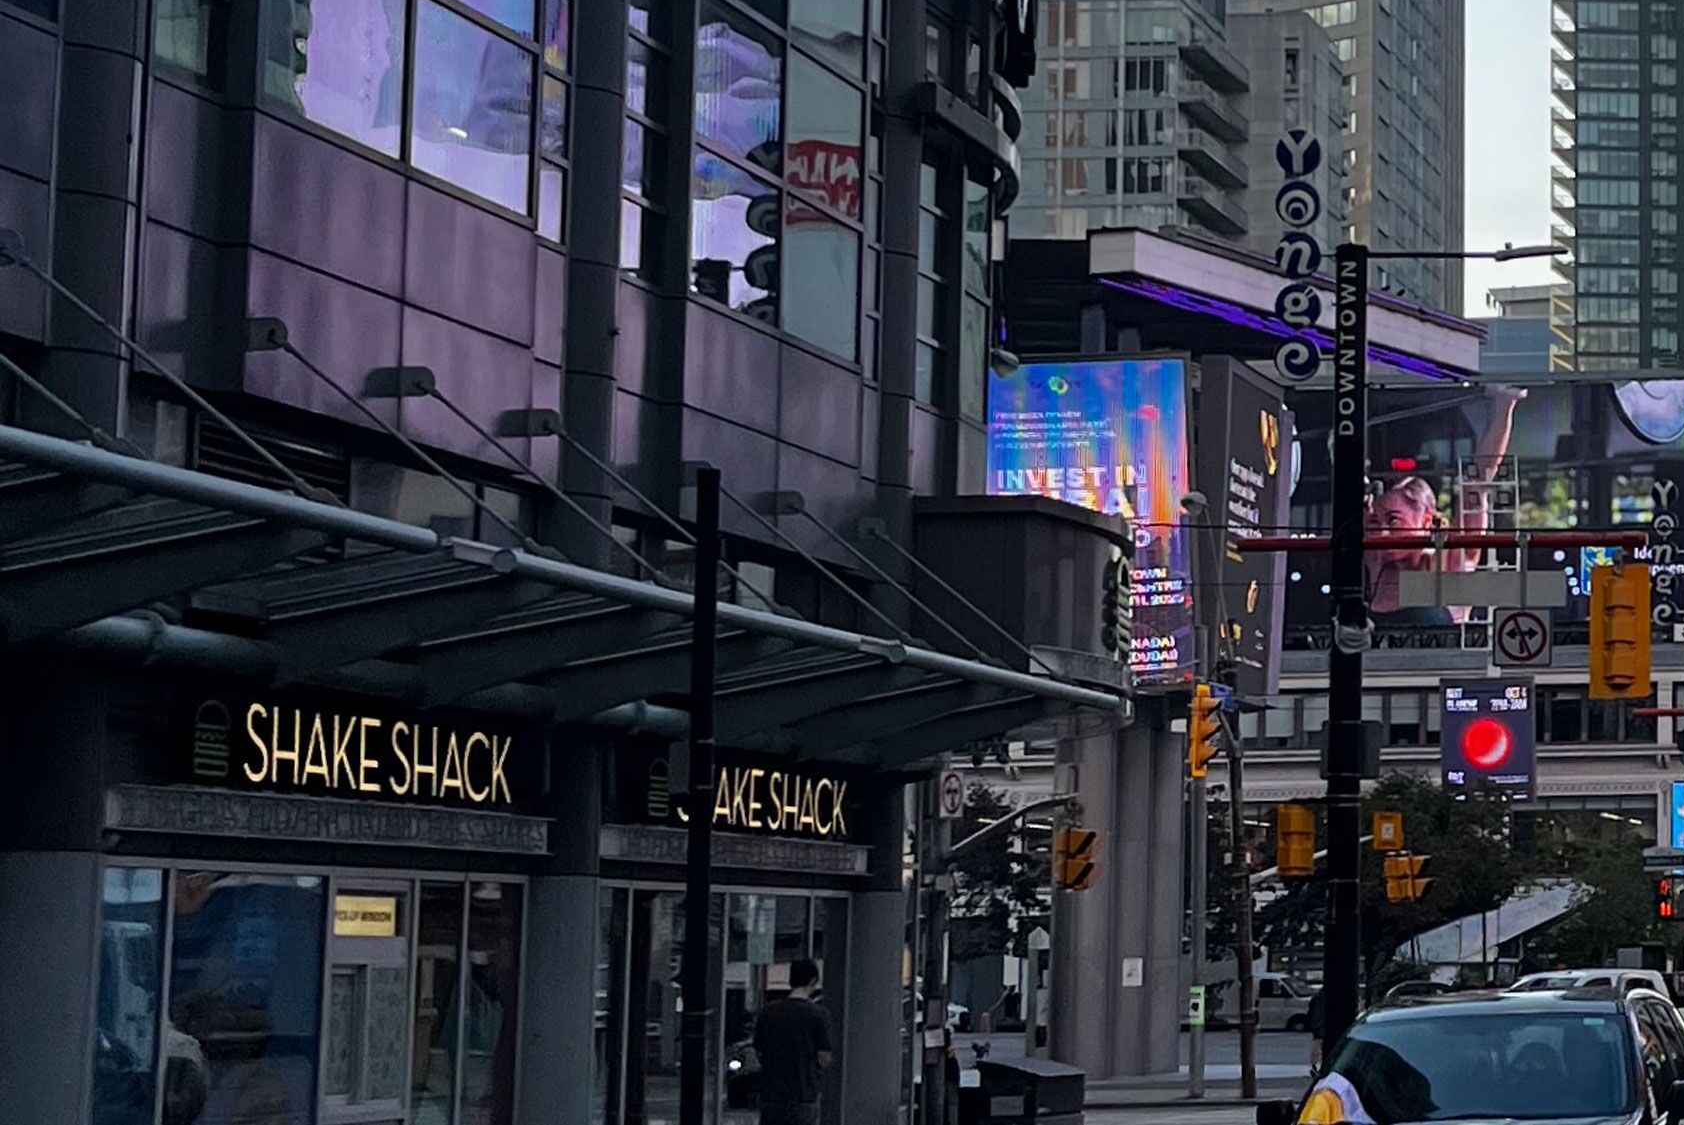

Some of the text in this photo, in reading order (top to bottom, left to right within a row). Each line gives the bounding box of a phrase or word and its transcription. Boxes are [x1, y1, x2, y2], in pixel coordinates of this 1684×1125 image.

[1339, 260, 1357, 436] DOWNTOWN
[996, 464, 1148, 489] INVEST IN
[243, 703, 512, 804] SHAKE SHACK
[767, 772, 847, 835] SHACK
